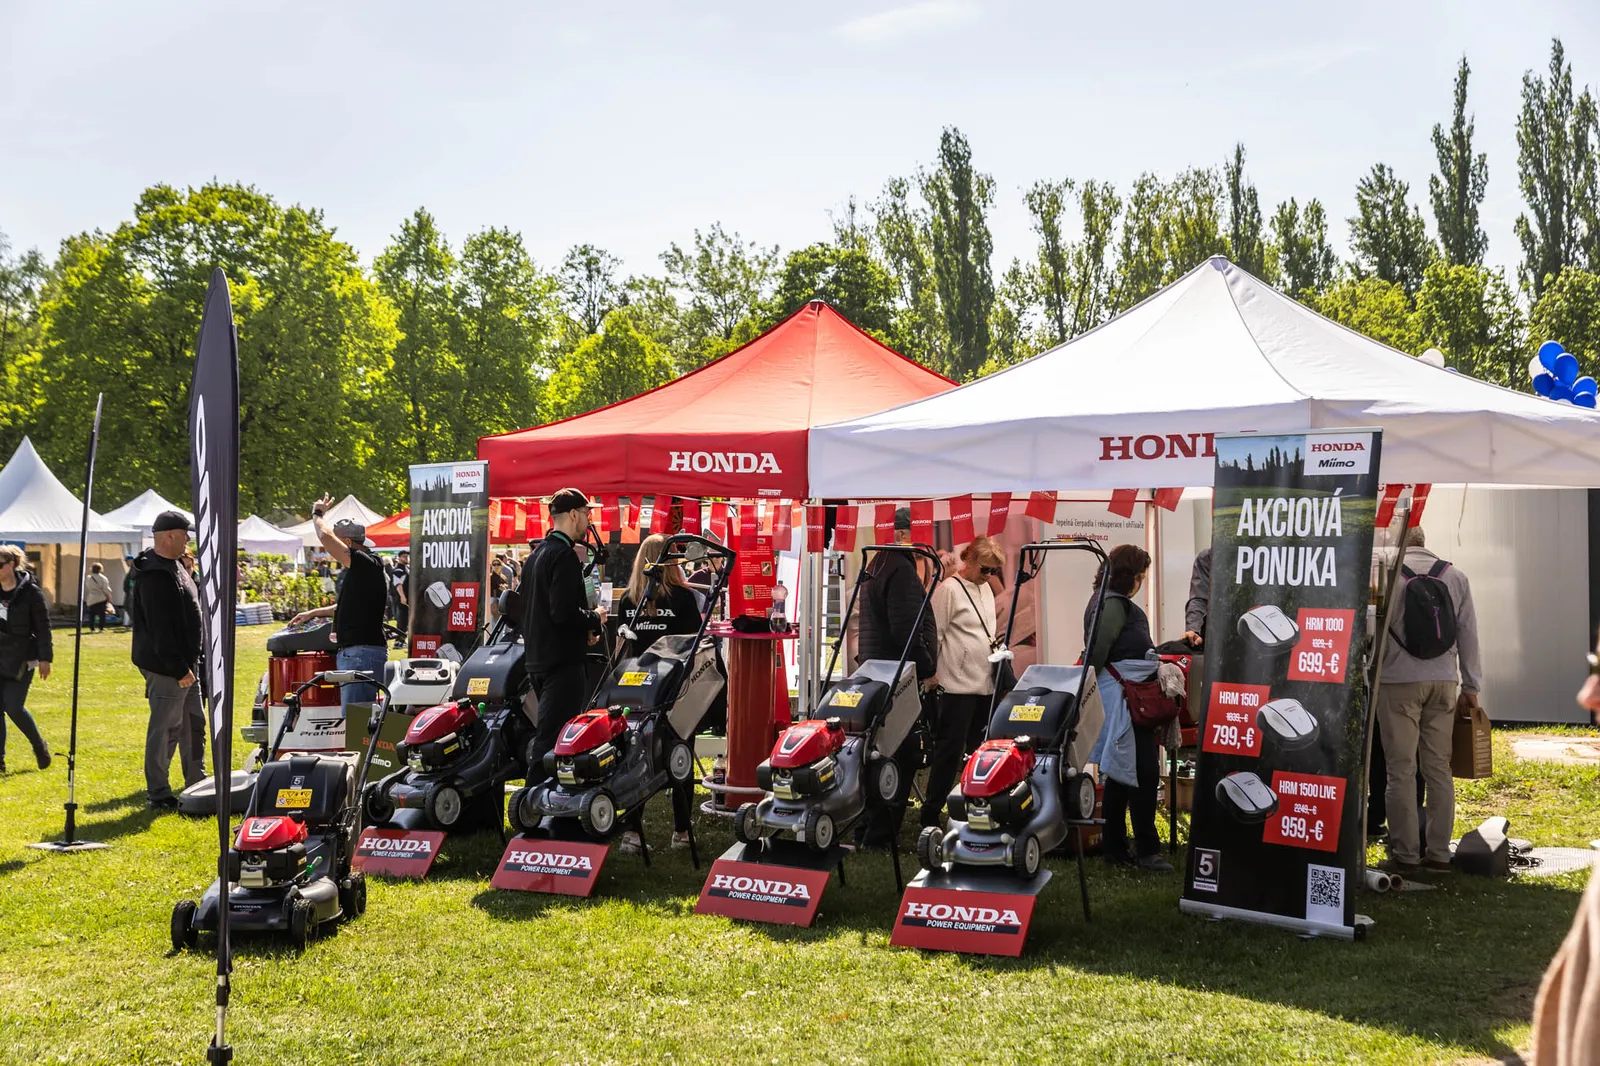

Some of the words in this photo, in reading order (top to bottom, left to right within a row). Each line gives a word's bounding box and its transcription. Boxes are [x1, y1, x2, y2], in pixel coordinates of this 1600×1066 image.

[1311, 443, 1365, 452] HONDA
[668, 451, 783, 474] HONDA
[1318, 458, 1355, 468] Miimo
[455, 470, 480, 478] HONDA
[422, 501, 472, 536] AKCIOVÁ
[1237, 487, 1343, 537] AKCIOVÁ
[422, 541, 471, 568] PONUKA
[1236, 546, 1337, 587] PONUKA
[452, 611, 473, 627] 699,-€
[635, 621, 668, 630] Miimo
[1305, 617, 1323, 630] HRM
[1325, 618, 1344, 631] 1000
[1298, 651, 1340, 676] 699,-€
[1219, 691, 1239, 705] HRM
[1240, 692, 1259, 707] 1500
[1212, 724, 1255, 750] 799,-€
[371, 754, 392, 768] iimo
[1279, 780, 1298, 795] HRM
[1299, 782, 1319, 798] 1500
[1319, 784, 1337, 800] LIVE
[1281, 815, 1324, 843] 959,-€
[359, 837, 432, 852] HONDA
[506, 850, 593, 870] HONDA
[1199, 853, 1213, 876] 5
[540, 866, 572, 876] EQUIPMENT
[711, 874, 811, 899] HONDA
[728, 890, 751, 900] POWER
[751, 892, 788, 904] EQUIPMENT
[904, 902, 1022, 925] HONDA
[926, 920, 953, 929] POWER
[953, 921, 996, 932] EQUIPMENT
